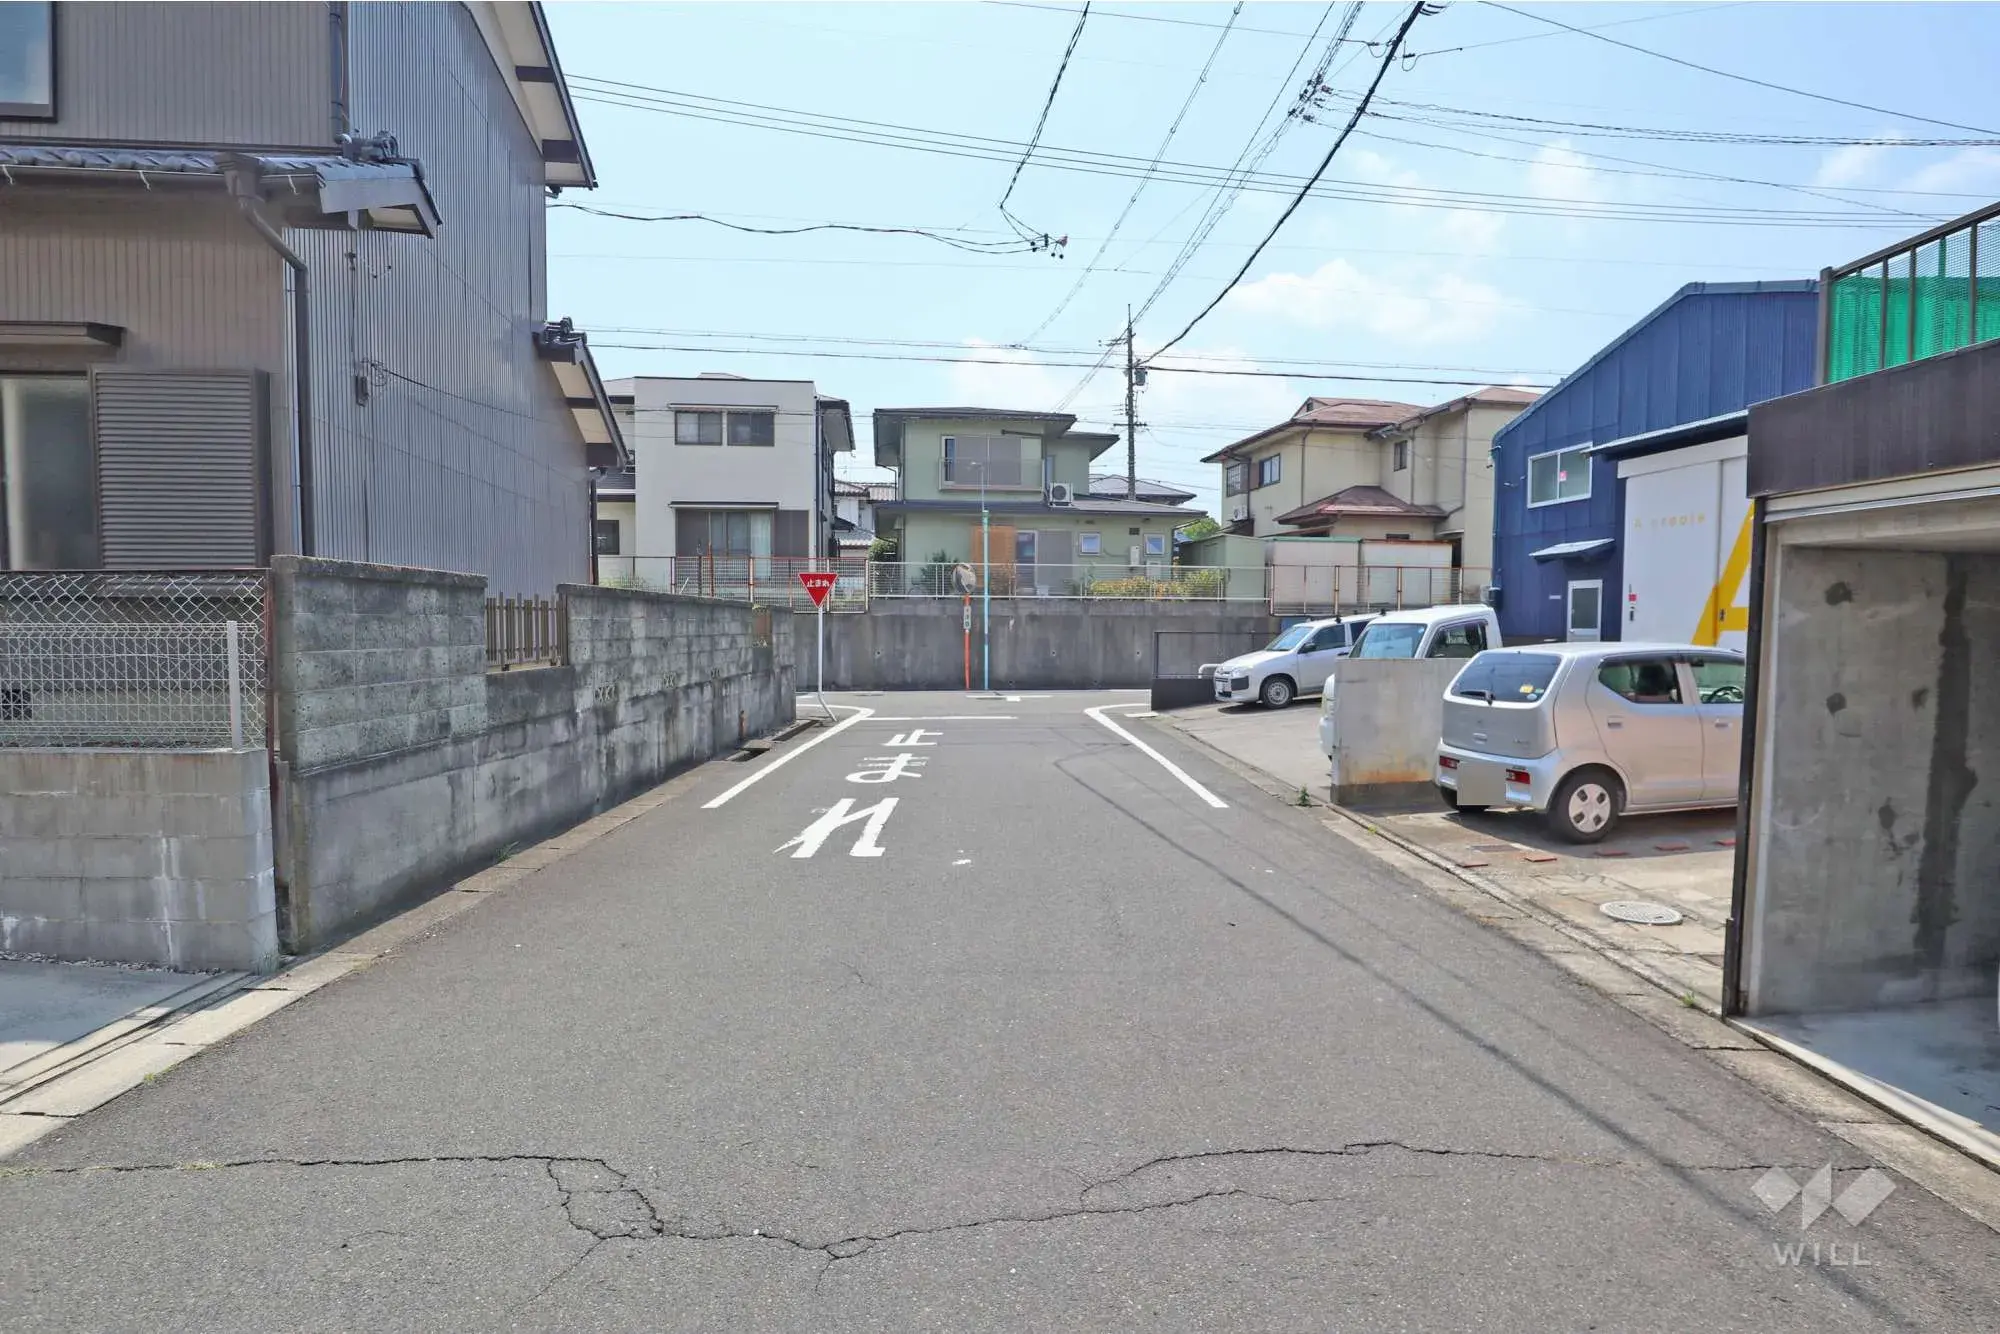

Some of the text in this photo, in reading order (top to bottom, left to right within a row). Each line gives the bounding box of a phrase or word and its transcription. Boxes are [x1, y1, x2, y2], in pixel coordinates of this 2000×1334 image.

[806, 578, 831, 588] 止まれ
[772, 728, 944, 858] 止まれ
